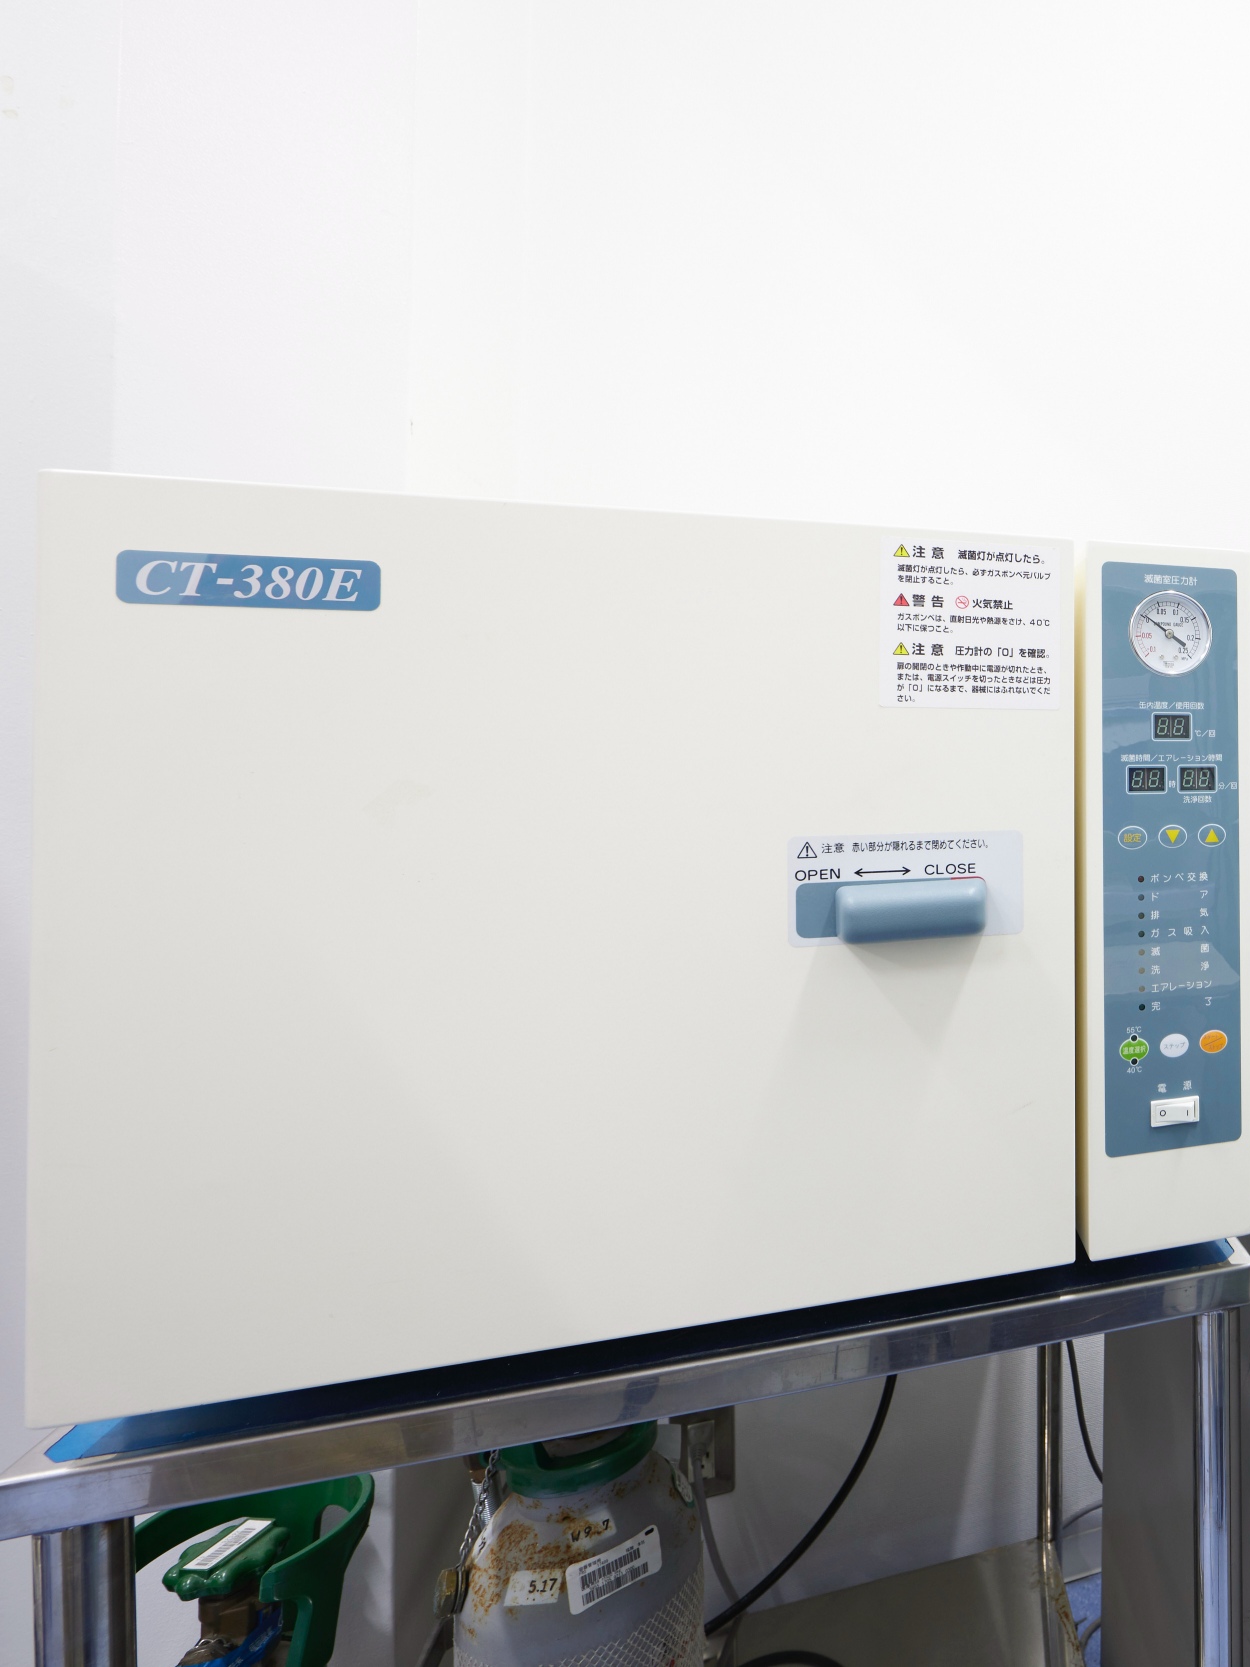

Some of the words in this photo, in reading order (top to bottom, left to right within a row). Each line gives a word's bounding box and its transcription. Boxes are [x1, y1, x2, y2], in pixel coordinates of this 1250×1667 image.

[912, 545, 945, 560] 注意
[135, 559, 363, 602] CT-380E
[912, 594, 944, 608] 警告
[972, 598, 1014, 610] 火気禁止
[911, 643, 944, 657] 注意
[896, 695, 916, 703] さい。
[821, 842, 845, 854] 注意
[795, 868, 841, 882] OPEN
[924, 863, 976, 876] CLOSE
[1151, 980, 1212, 993] エアレーション
[528, 1578, 558, 1593] 5.17
